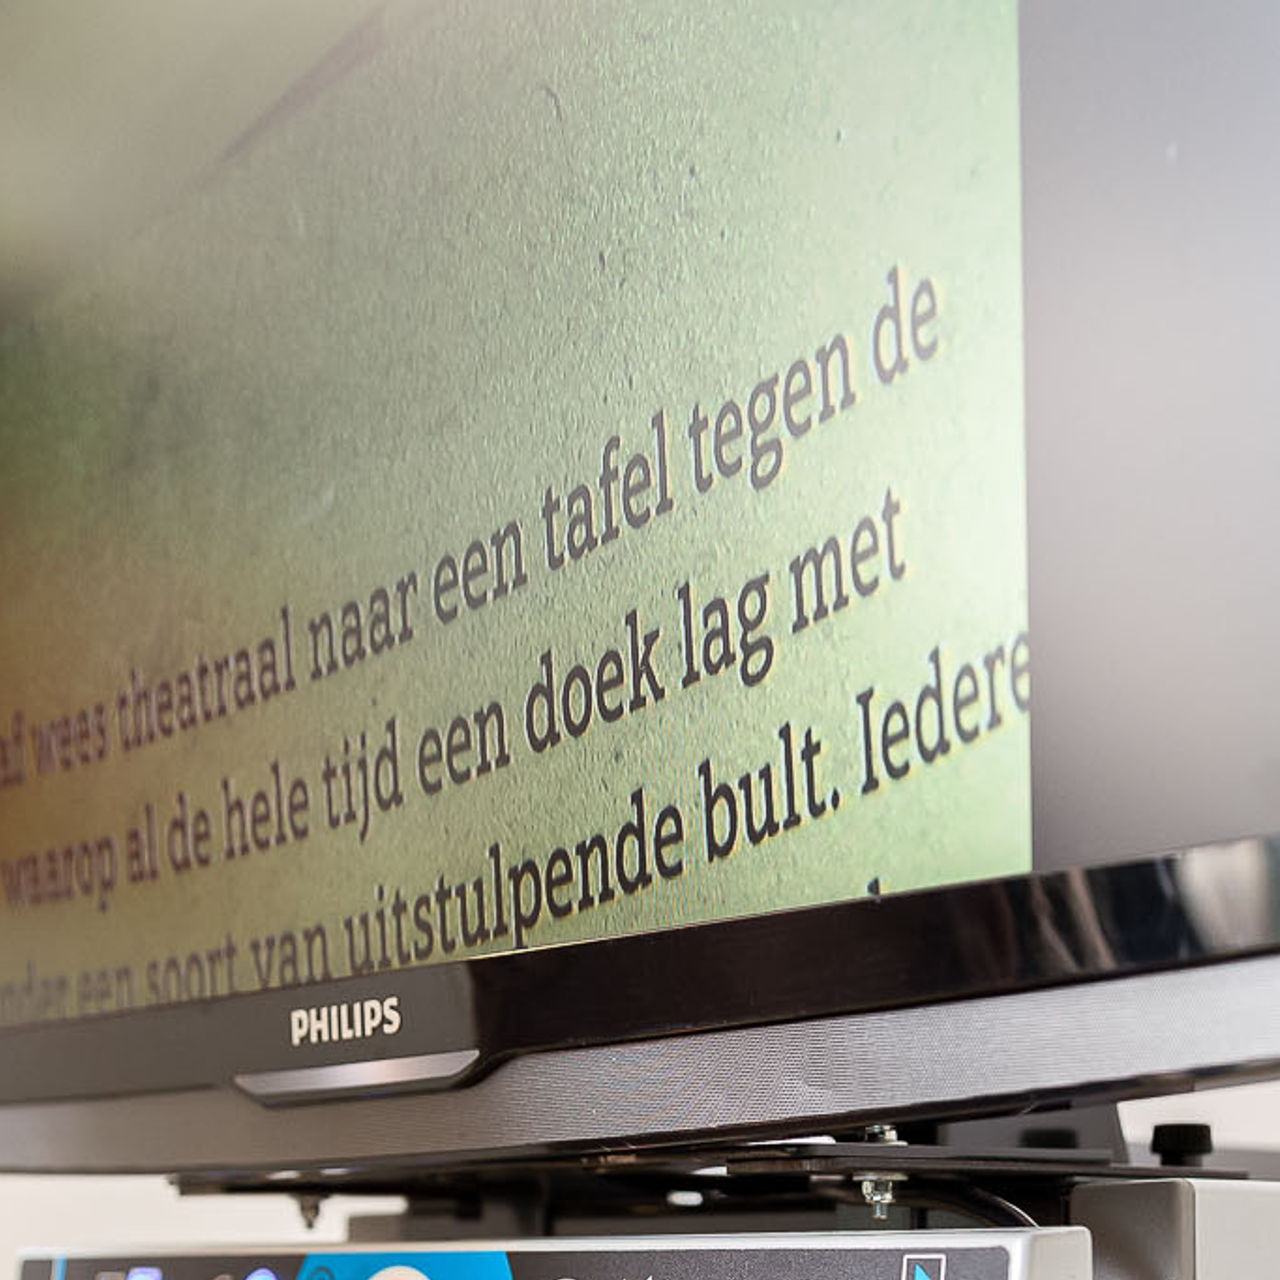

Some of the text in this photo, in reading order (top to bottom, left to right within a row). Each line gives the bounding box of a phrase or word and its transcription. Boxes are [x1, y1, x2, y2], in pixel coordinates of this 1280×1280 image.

[2, 834, 118, 912] waarop
[127, 803, 160, 885] al
[166, 791, 216, 874] de
[221, 758, 311, 860] hele
[321, 715, 404, 843] tijd
[418, 700, 512, 795] een
[524, 607, 667, 755] doek
[677, 570, 776, 688] lag
[788, 486, 907, 635] met
[31, 702, 108, 775] wees
[118, 604, 297, 752] theatraal
[307, 569, 418, 682] naar
[432, 518, 528, 627] een
[540, 409, 675, 572] tafel
[687, 332, 857, 495] tegen
[871, 264, 939, 386] de
[146, 930, 238, 1004] soort
[250, 920, 333, 990] van
[343, 786, 685, 970] uitstulpende
[698, 720, 841, 869] bult.
[855, 630, 1032, 797] Iedere
[290, 996, 402, 1047] PHILIPS
